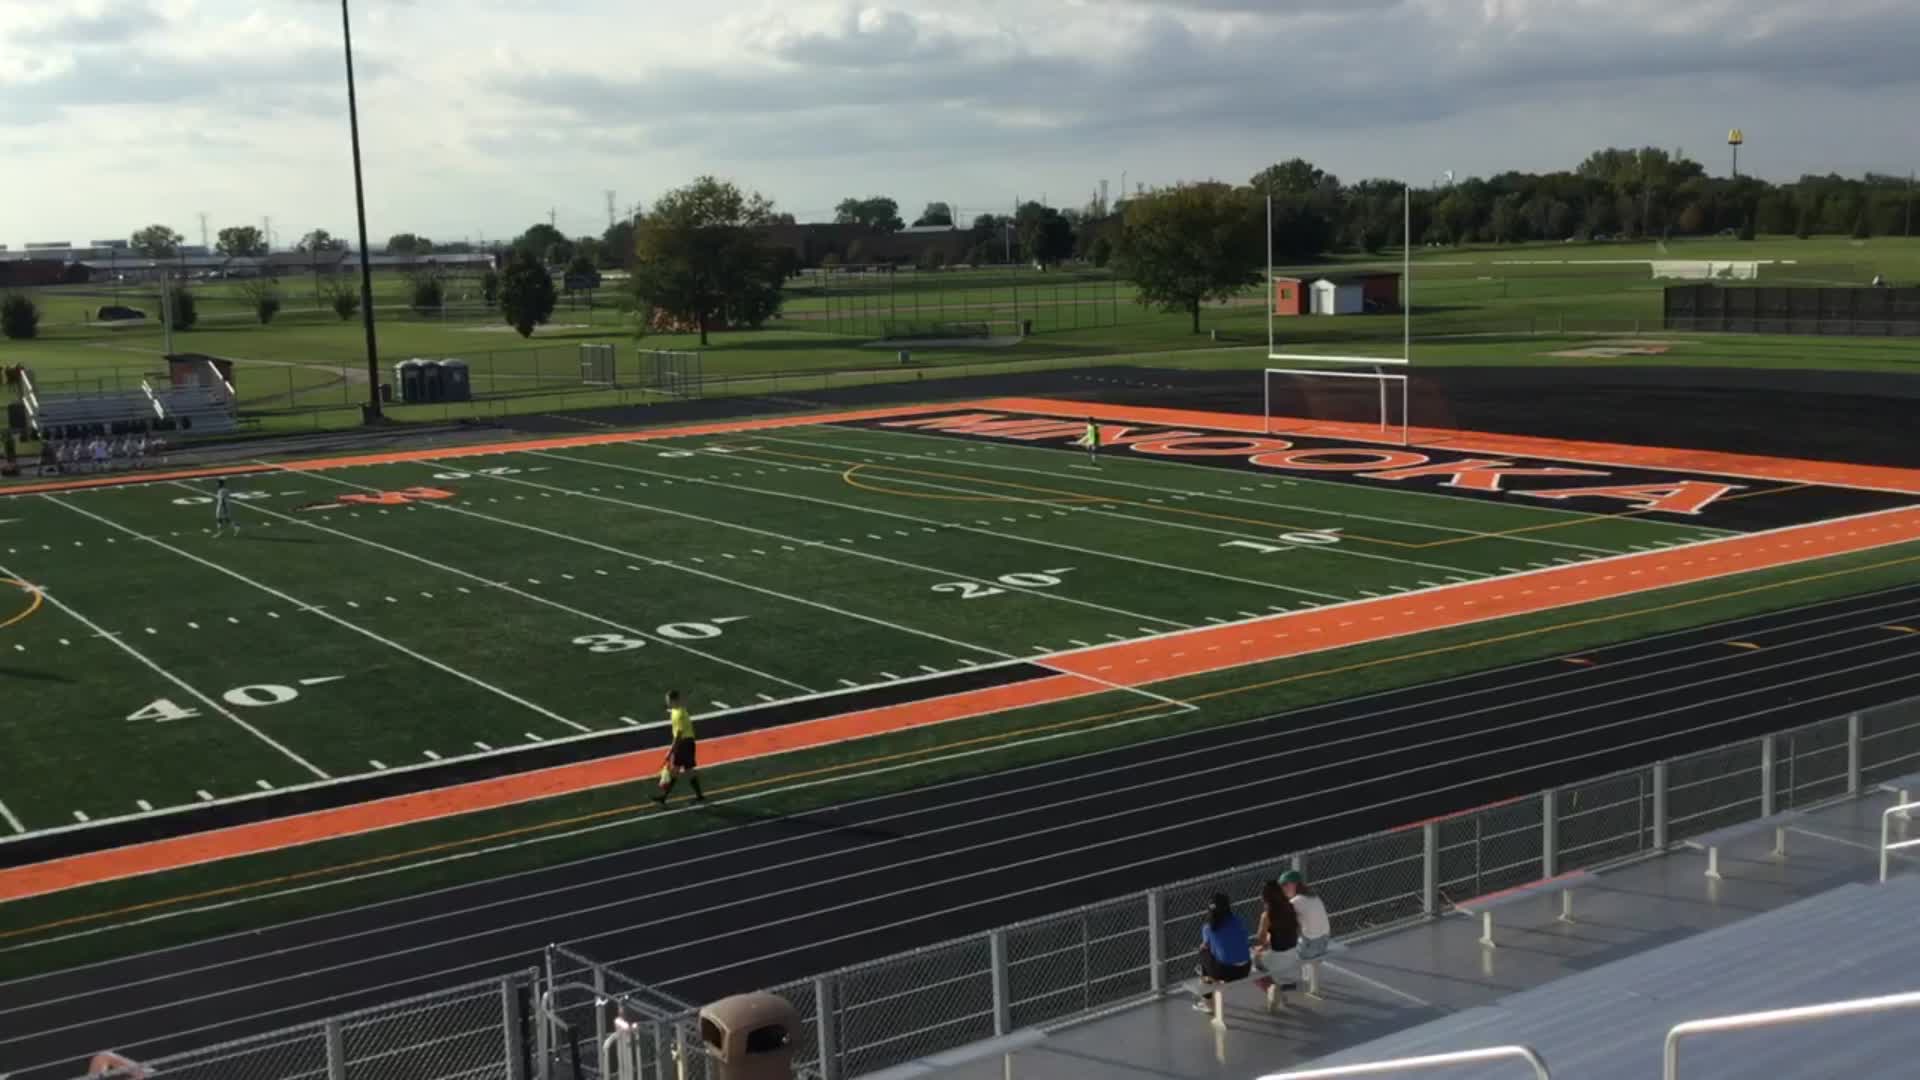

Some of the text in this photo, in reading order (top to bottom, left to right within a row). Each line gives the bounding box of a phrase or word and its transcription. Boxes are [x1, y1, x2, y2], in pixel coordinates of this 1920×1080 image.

[878, 412, 1749, 515] MINOOKA
[1218, 531, 1342, 554] 10
[930, 572, 1063, 600] 20
[571, 621, 723, 653] 30
[126, 683, 299, 723] 40
